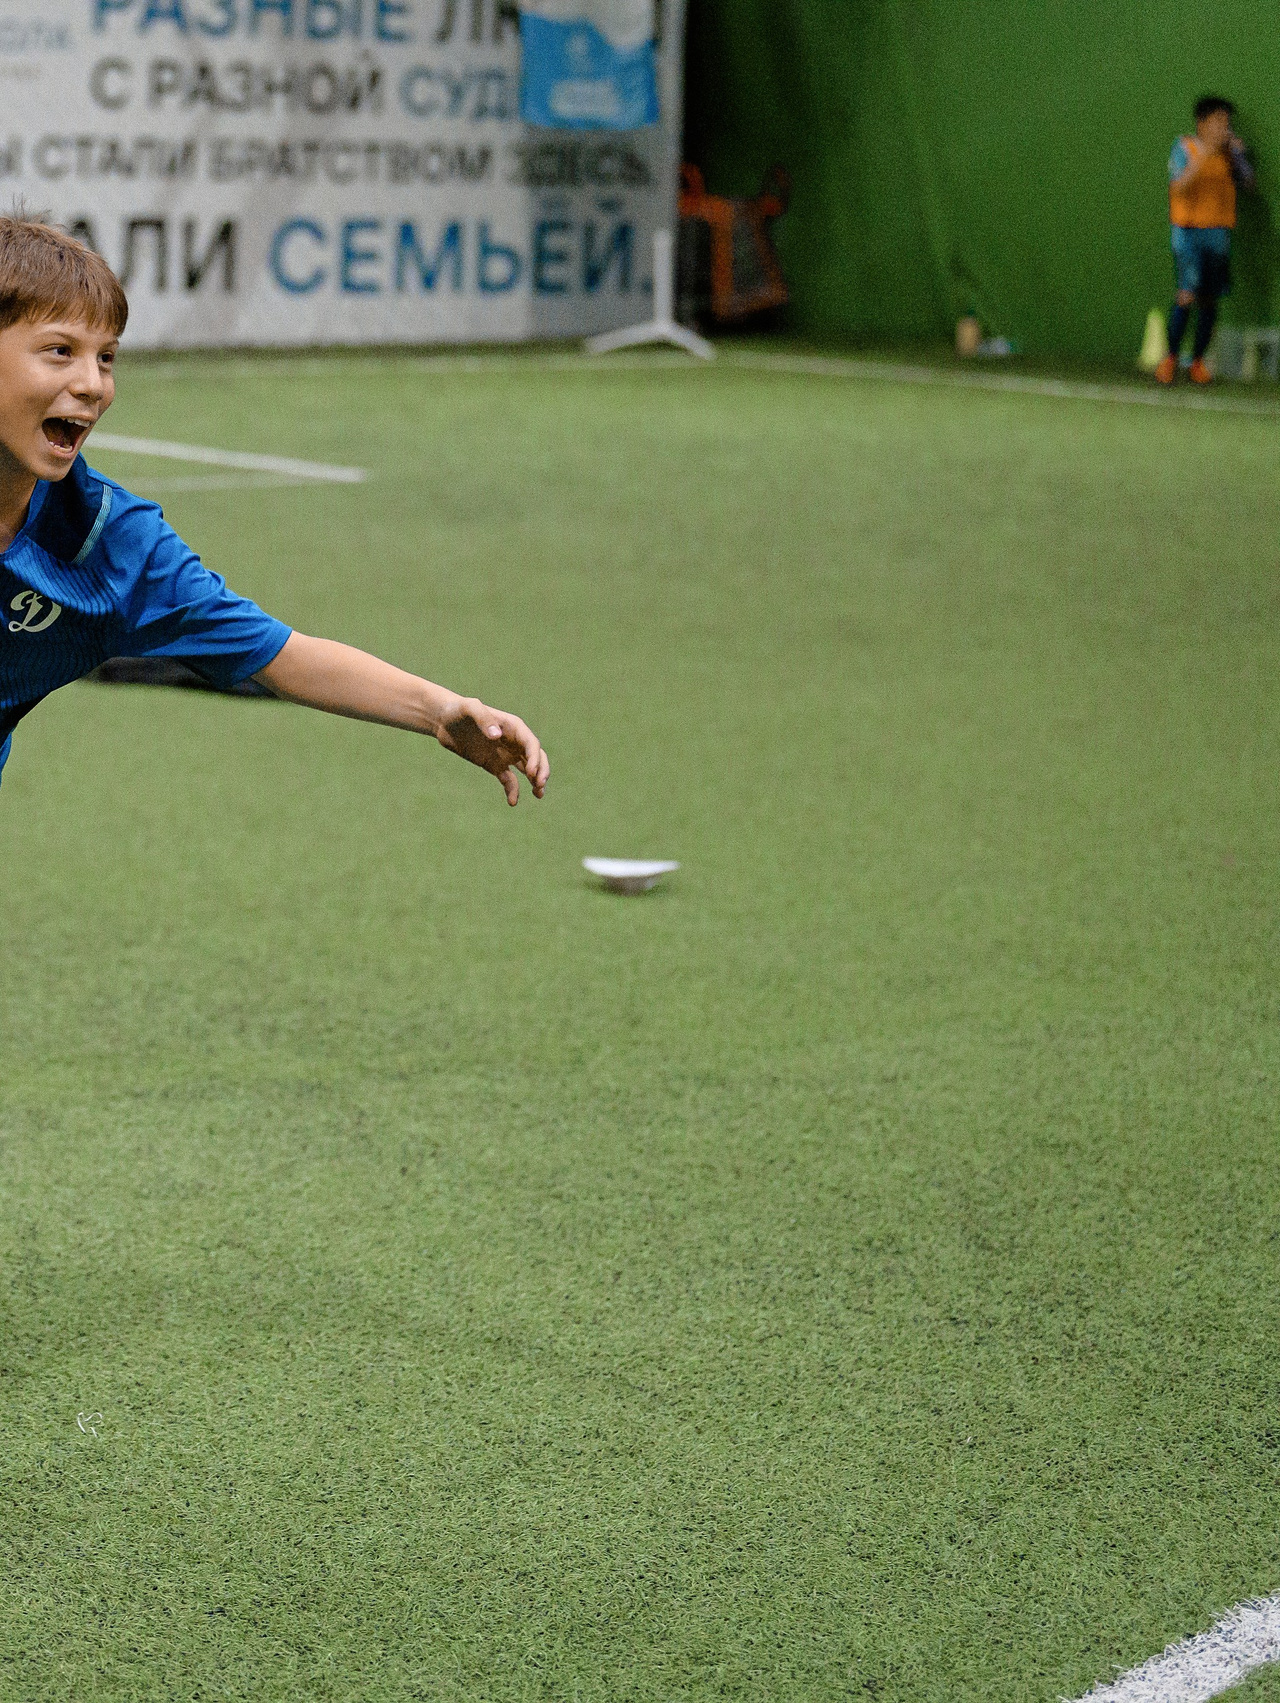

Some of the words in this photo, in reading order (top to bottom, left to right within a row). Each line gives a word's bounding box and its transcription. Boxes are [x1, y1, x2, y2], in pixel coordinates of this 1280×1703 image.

[91, 0, 410, 43] РАЗНЫЕ
[88, 55, 133, 111] С
[147, 50, 384, 116] РАЗНОЙ
[398, 63, 519, 121] СУД
[29, 134, 196, 181] СТАЛИ
[209, 137, 494, 187] БРАТСТВОМ
